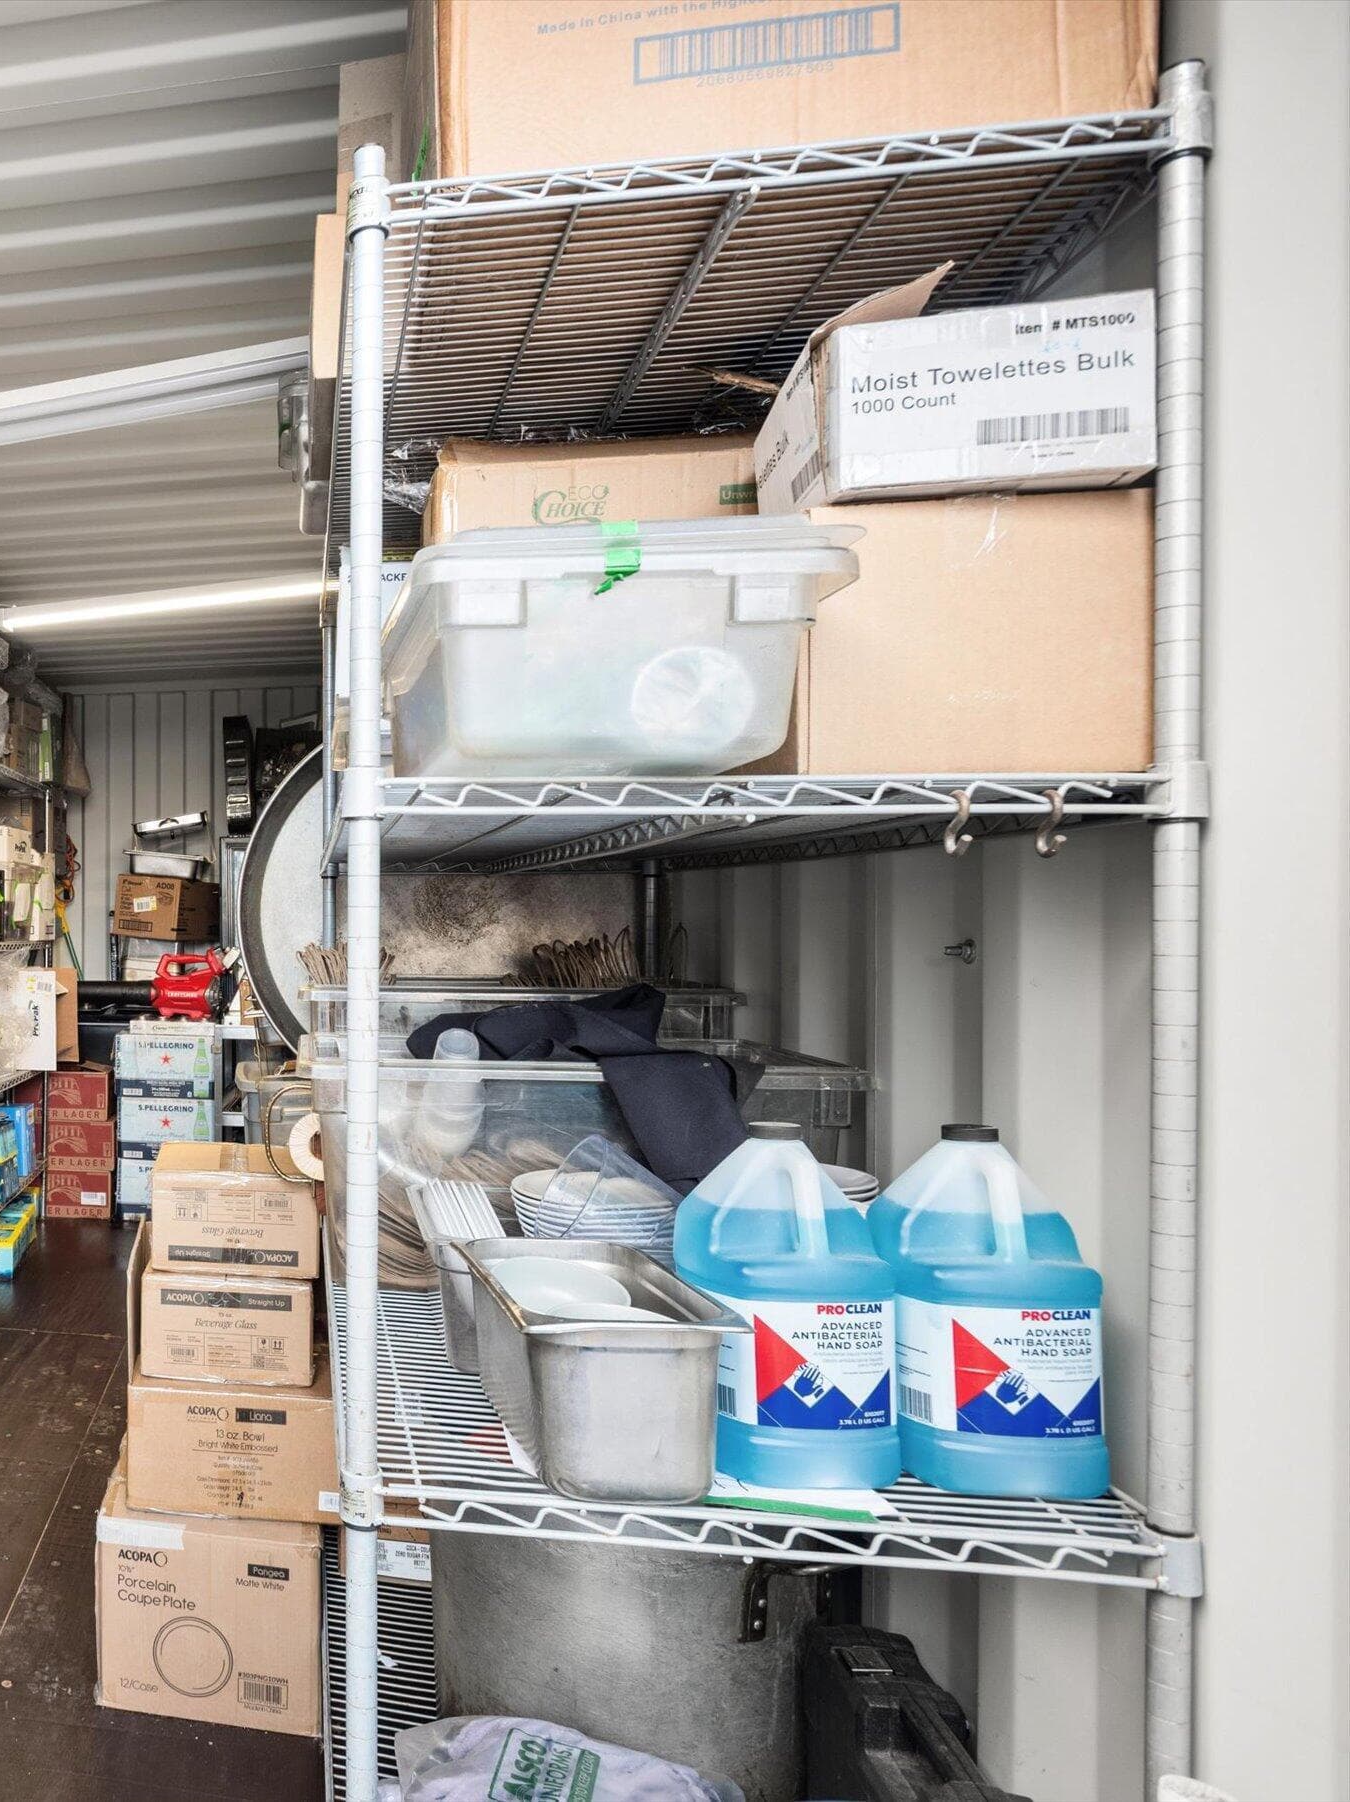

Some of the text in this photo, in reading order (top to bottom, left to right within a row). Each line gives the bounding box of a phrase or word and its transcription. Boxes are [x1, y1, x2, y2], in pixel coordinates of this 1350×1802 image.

[537, 2, 709, 35] Made in China with the
[1052, 320, 1061, 331] #
[1065, 312, 1135, 330] MTS1000
[851, 349, 1134, 394] Moist Towelettes Bulk
[851, 391, 956, 415] 1000 Count
[138, 1041, 194, 1050] S.PELLEGRINO
[63, 1110, 100, 1119] LAGER
[138, 1104, 194, 1113] S.PELLEGRINO
[70, 1158, 107, 1167] LAGER
[66, 1207, 103, 1217] LAGER
[266, 1255, 294, 1264] ACOPA
[165, 1292, 285, 1308] ACOPA Straight Up
[816, 1303, 883, 1315] PROCLEAN
[1021, 1309, 1092, 1322] PROCLEAN
[194, 1317, 258, 1330] Beverage Glass
[821, 1321, 883, 1331] ADVANCED
[791, 1331, 883, 1340] ANTIBACTERIAL
[1026, 1328, 1092, 1338] ADVANCED
[816, 1340, 883, 1350] HAND SOAP
[993, 1337, 1092, 1347] ANTIBACTERIAL
[1021, 1348, 1092, 1357] HAND SOAP
[187, 1405, 218, 1417] ACOPA
[249, 1410, 273, 1422] Liana
[215, 1429, 225, 1438] 13
[242, 1430, 265, 1442] Bowl
[198, 1439, 278, 1453] Bright White Embossed
[117, 1549, 153, 1564] ACOPA
[252, 1565, 286, 1579] Pangea
[117, 1573, 177, 1594] Porcelain
[235, 1577, 285, 1592] Matte White
[117, 1589, 196, 1611] Coupe Plate
[119, 1677, 159, 1693] 12/Case
[503, 1739, 547, 1802] ALSCO
